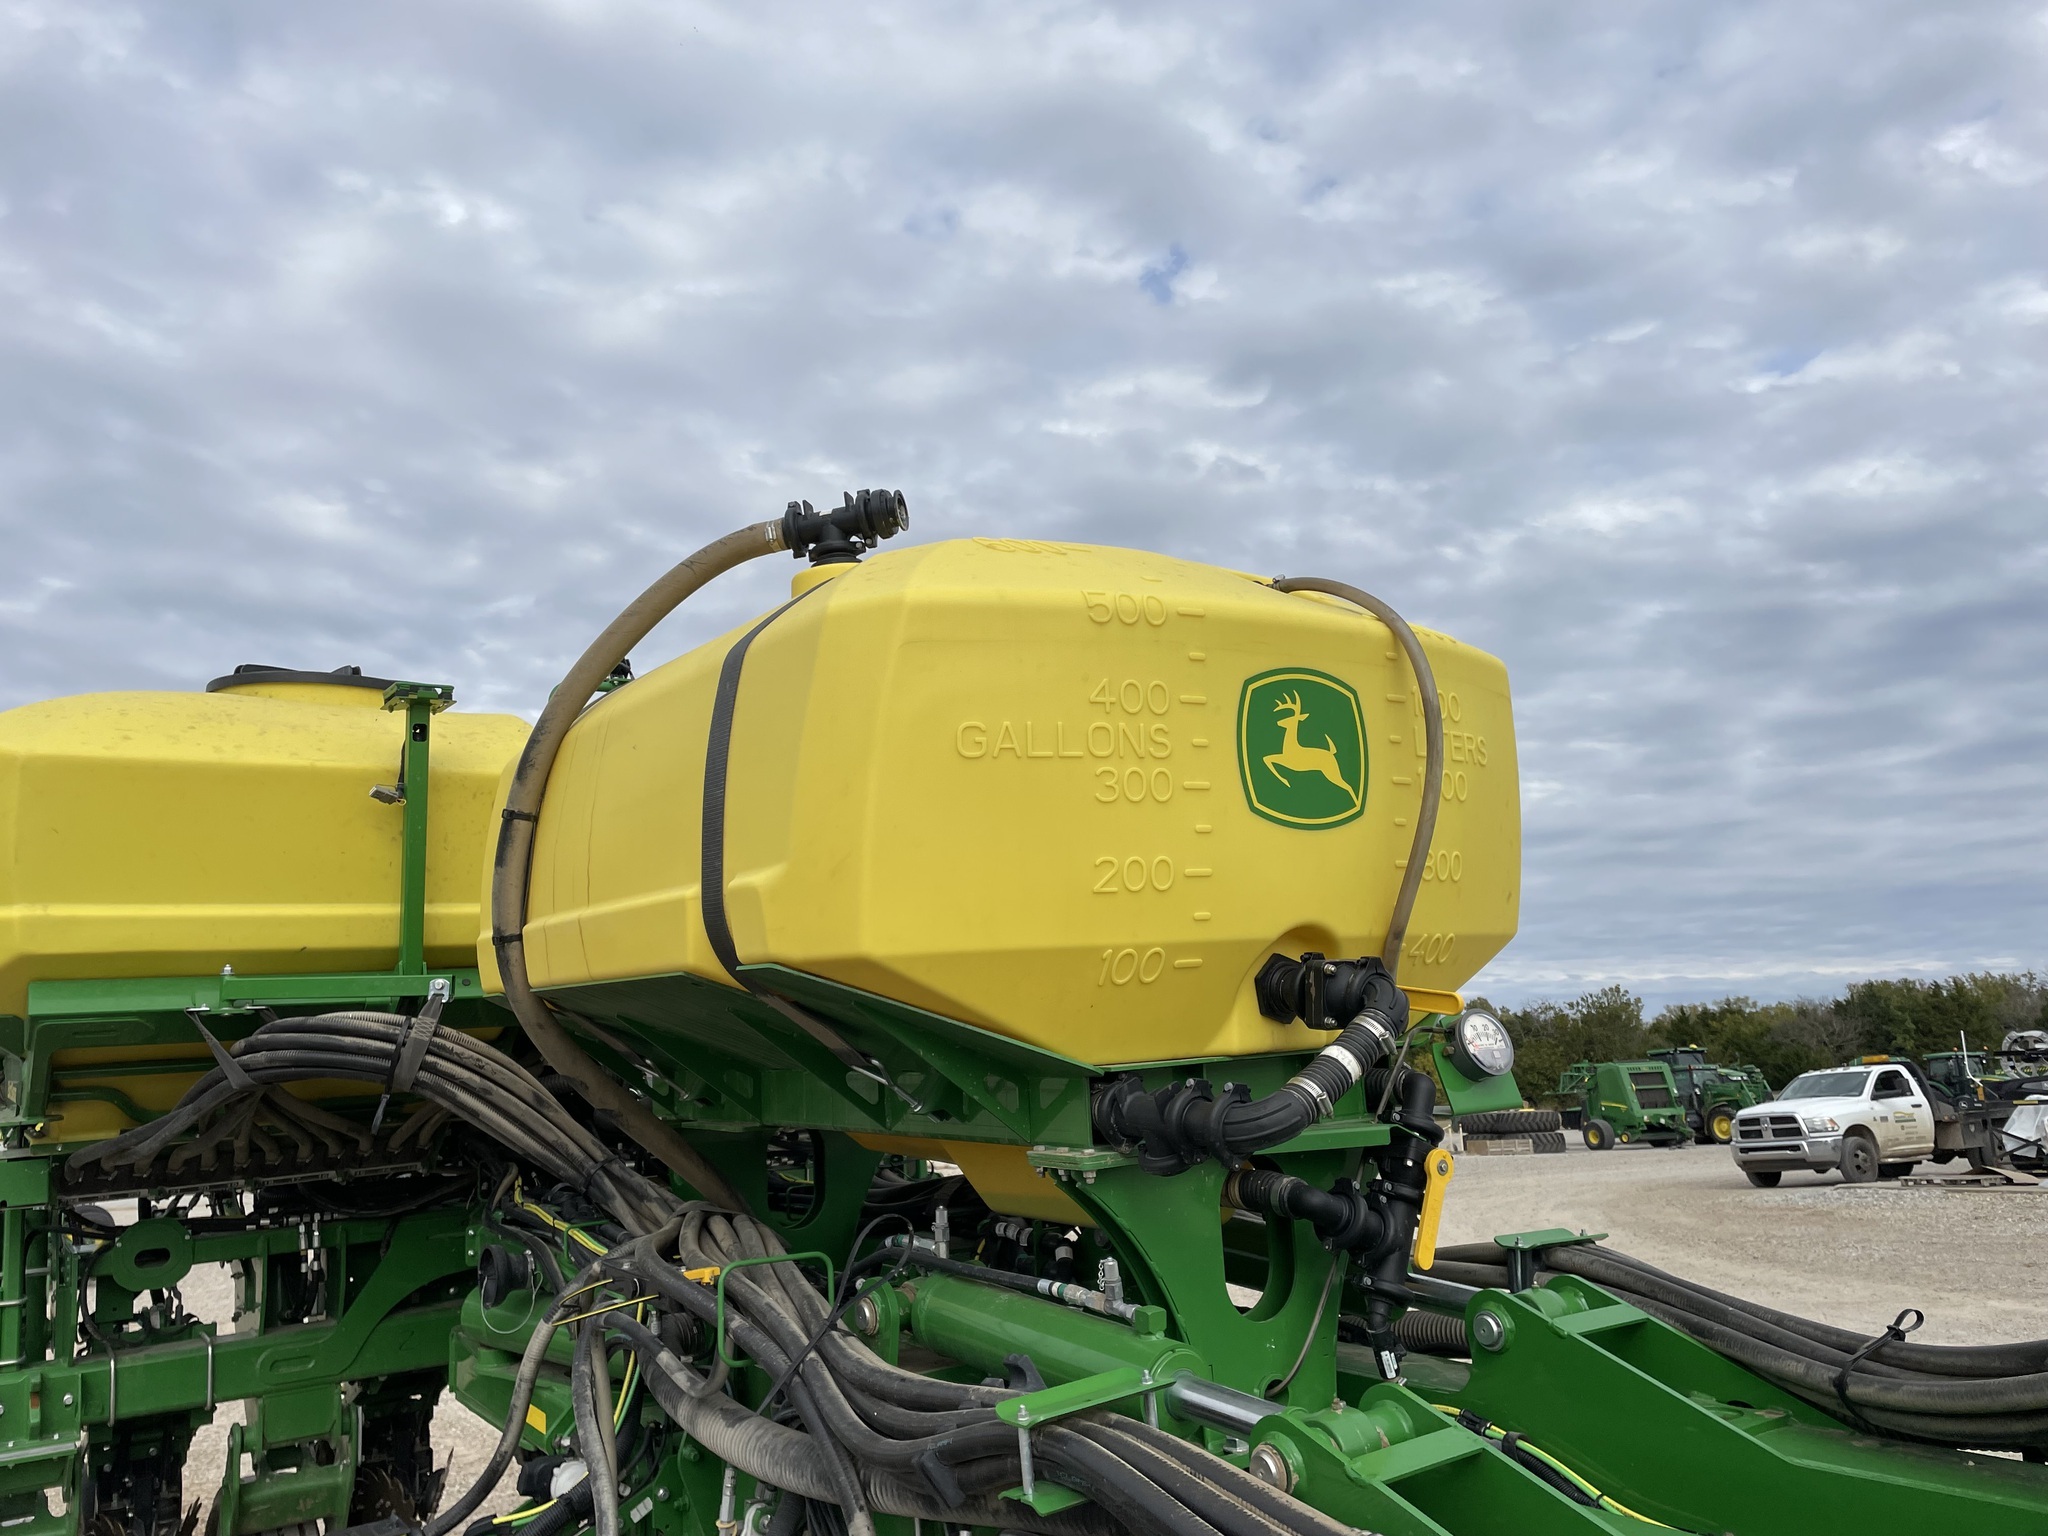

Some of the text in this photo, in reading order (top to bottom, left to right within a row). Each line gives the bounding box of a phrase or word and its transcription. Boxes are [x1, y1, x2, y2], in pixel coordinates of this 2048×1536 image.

[1081, 588, 1168, 626] 500
[1088, 678, 1170, 715] 400
[1411, 686, 1461, 722] 100
[956, 720, 1172, 760] GALLONS
[1094, 766, 1174, 803] 300
[1416, 766, 1468, 802] 100
[1092, 855, 1175, 894] 200
[1098, 946, 1167, 986] 100
[1408, 932, 1456, 966] 400
